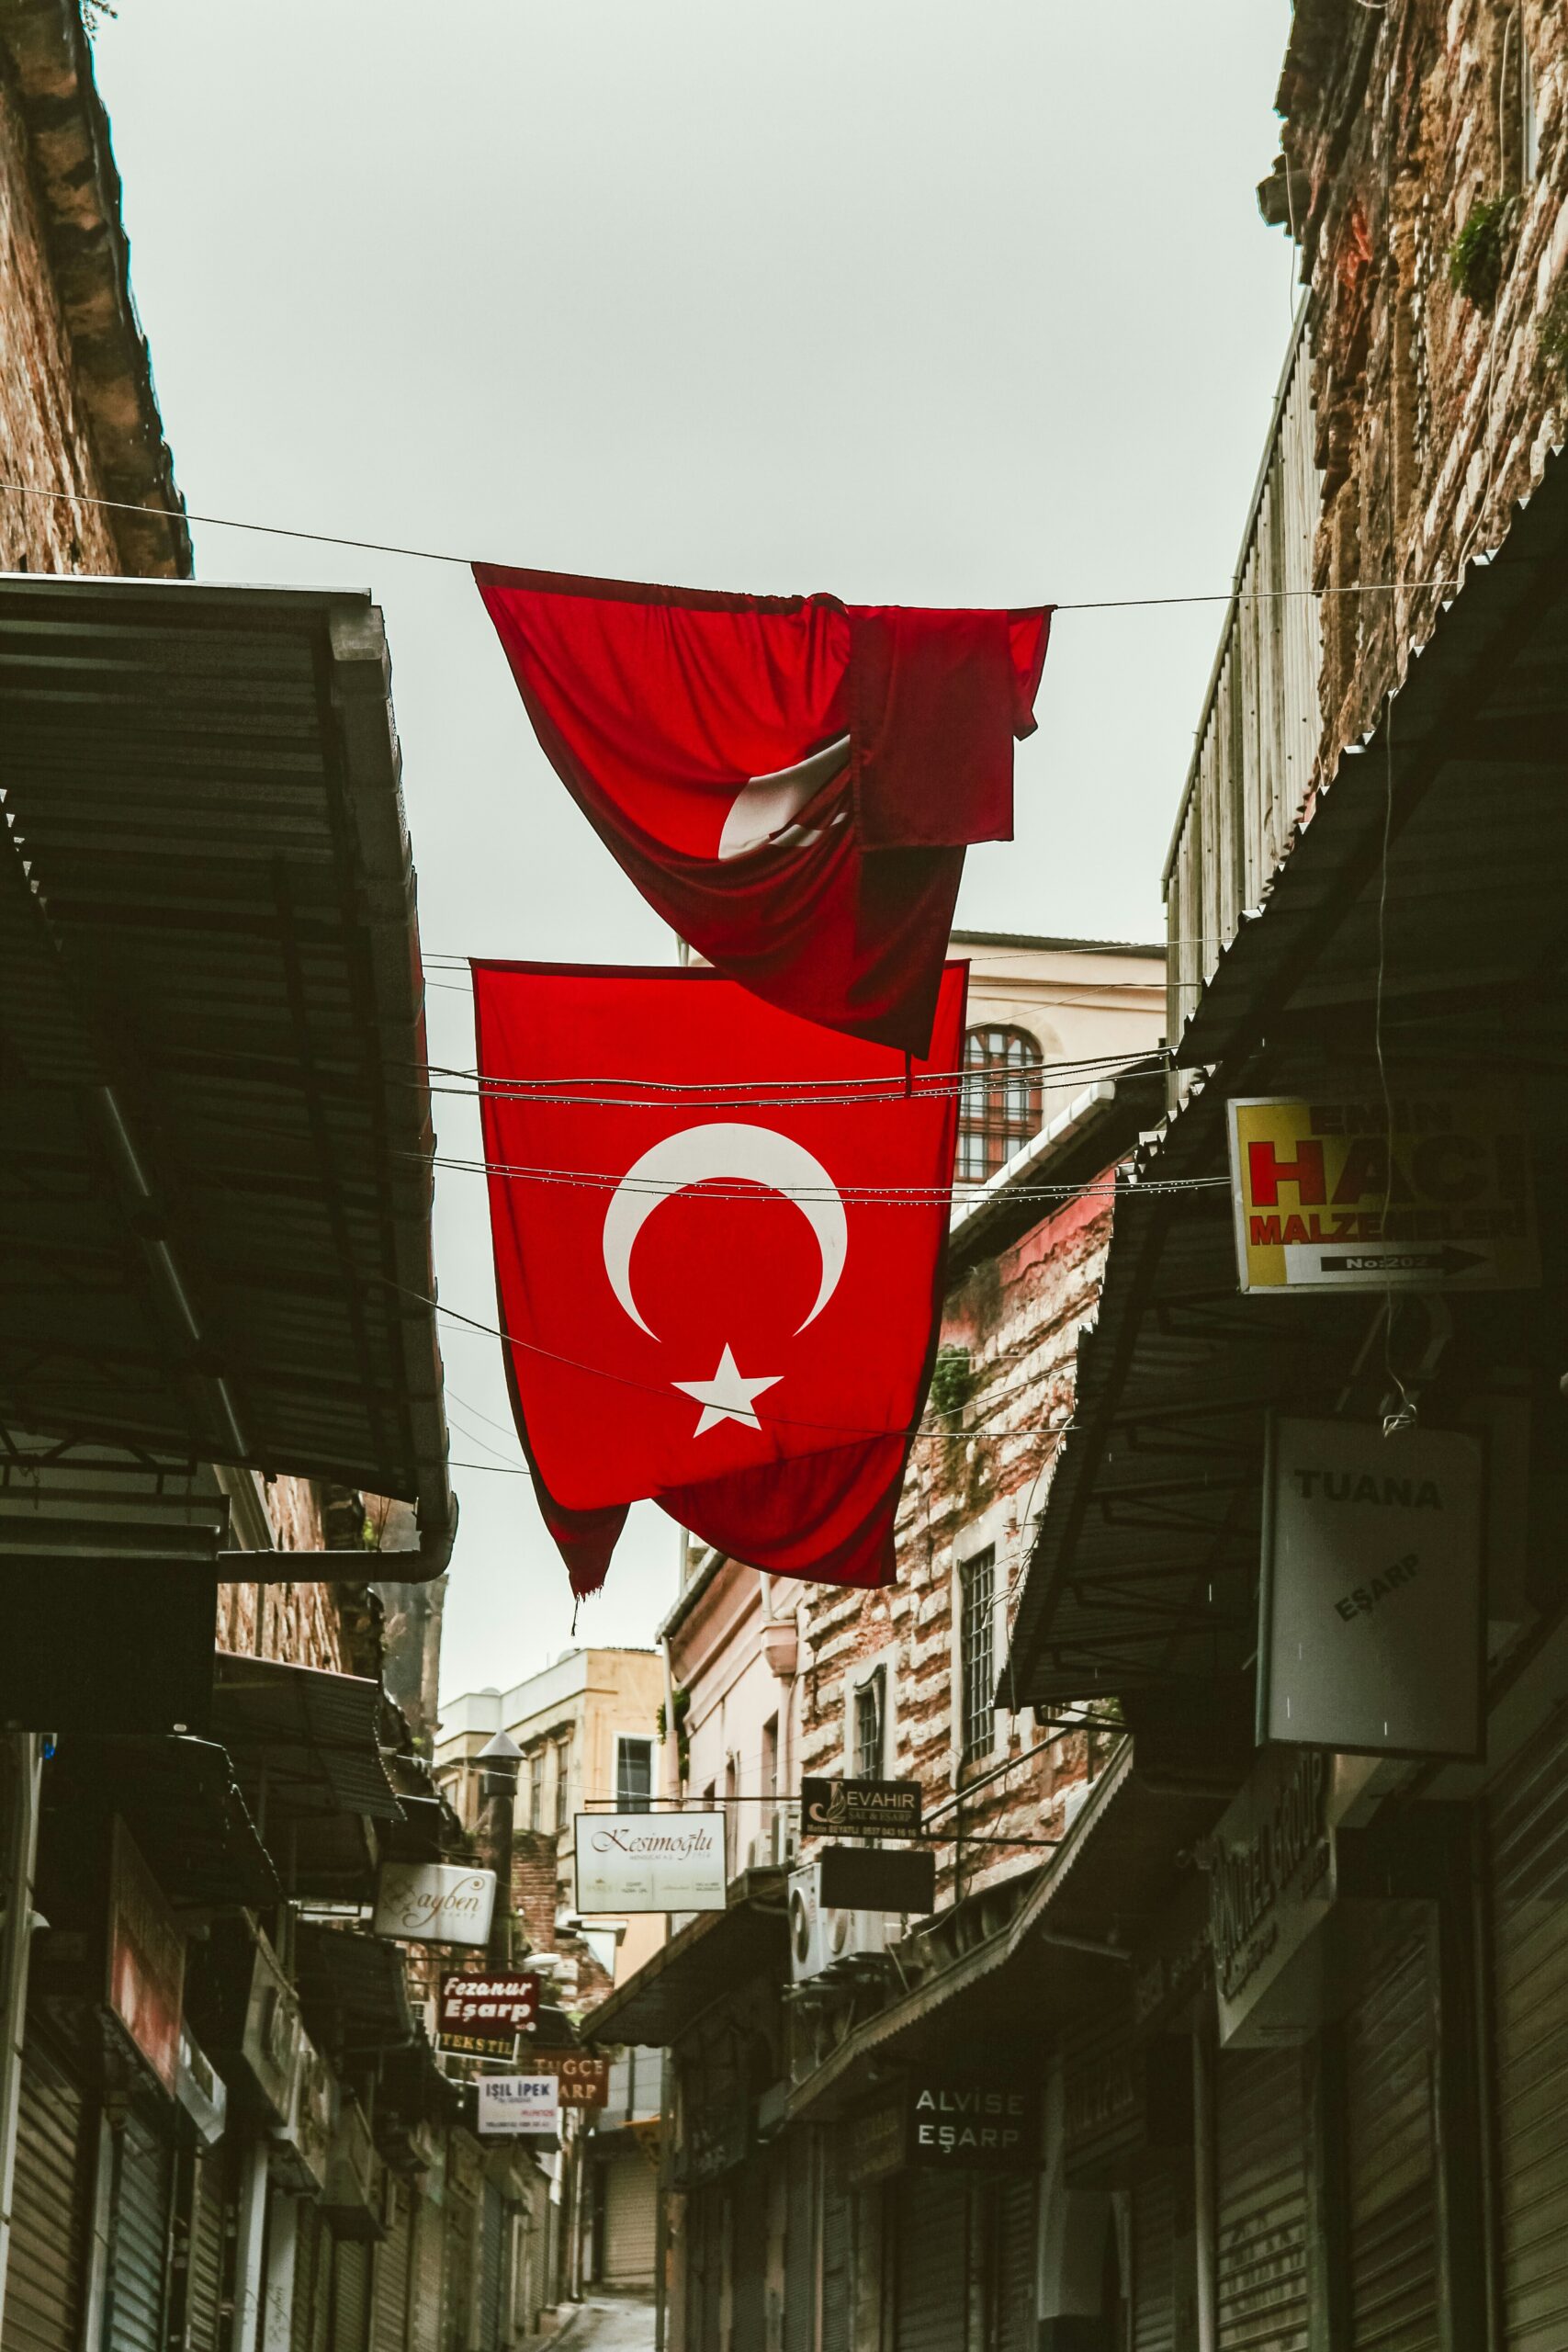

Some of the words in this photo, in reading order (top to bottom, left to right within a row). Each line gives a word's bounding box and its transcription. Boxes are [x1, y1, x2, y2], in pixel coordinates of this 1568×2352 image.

[1293, 1469, 1443, 1510] TUANA
[1335, 1554, 1420, 1622] EŞARP
[591, 1828, 713, 1860] Kesimoğlu
[444, 1977, 533, 1996] Fezanur
[445, 1998, 532, 2022] Eşarp
[442, 2033, 513, 2055] TEKSTİL
[534, 2057, 604, 2077] TUĞÇE
[486, 2083, 513, 2099] IŞIL
[518, 2080, 550, 2097] İPEK
[558, 2084, 597, 2099] ARP
[915, 2087, 1025, 2115] ALVİSE
[918, 2124, 1020, 2154] EŞARP
